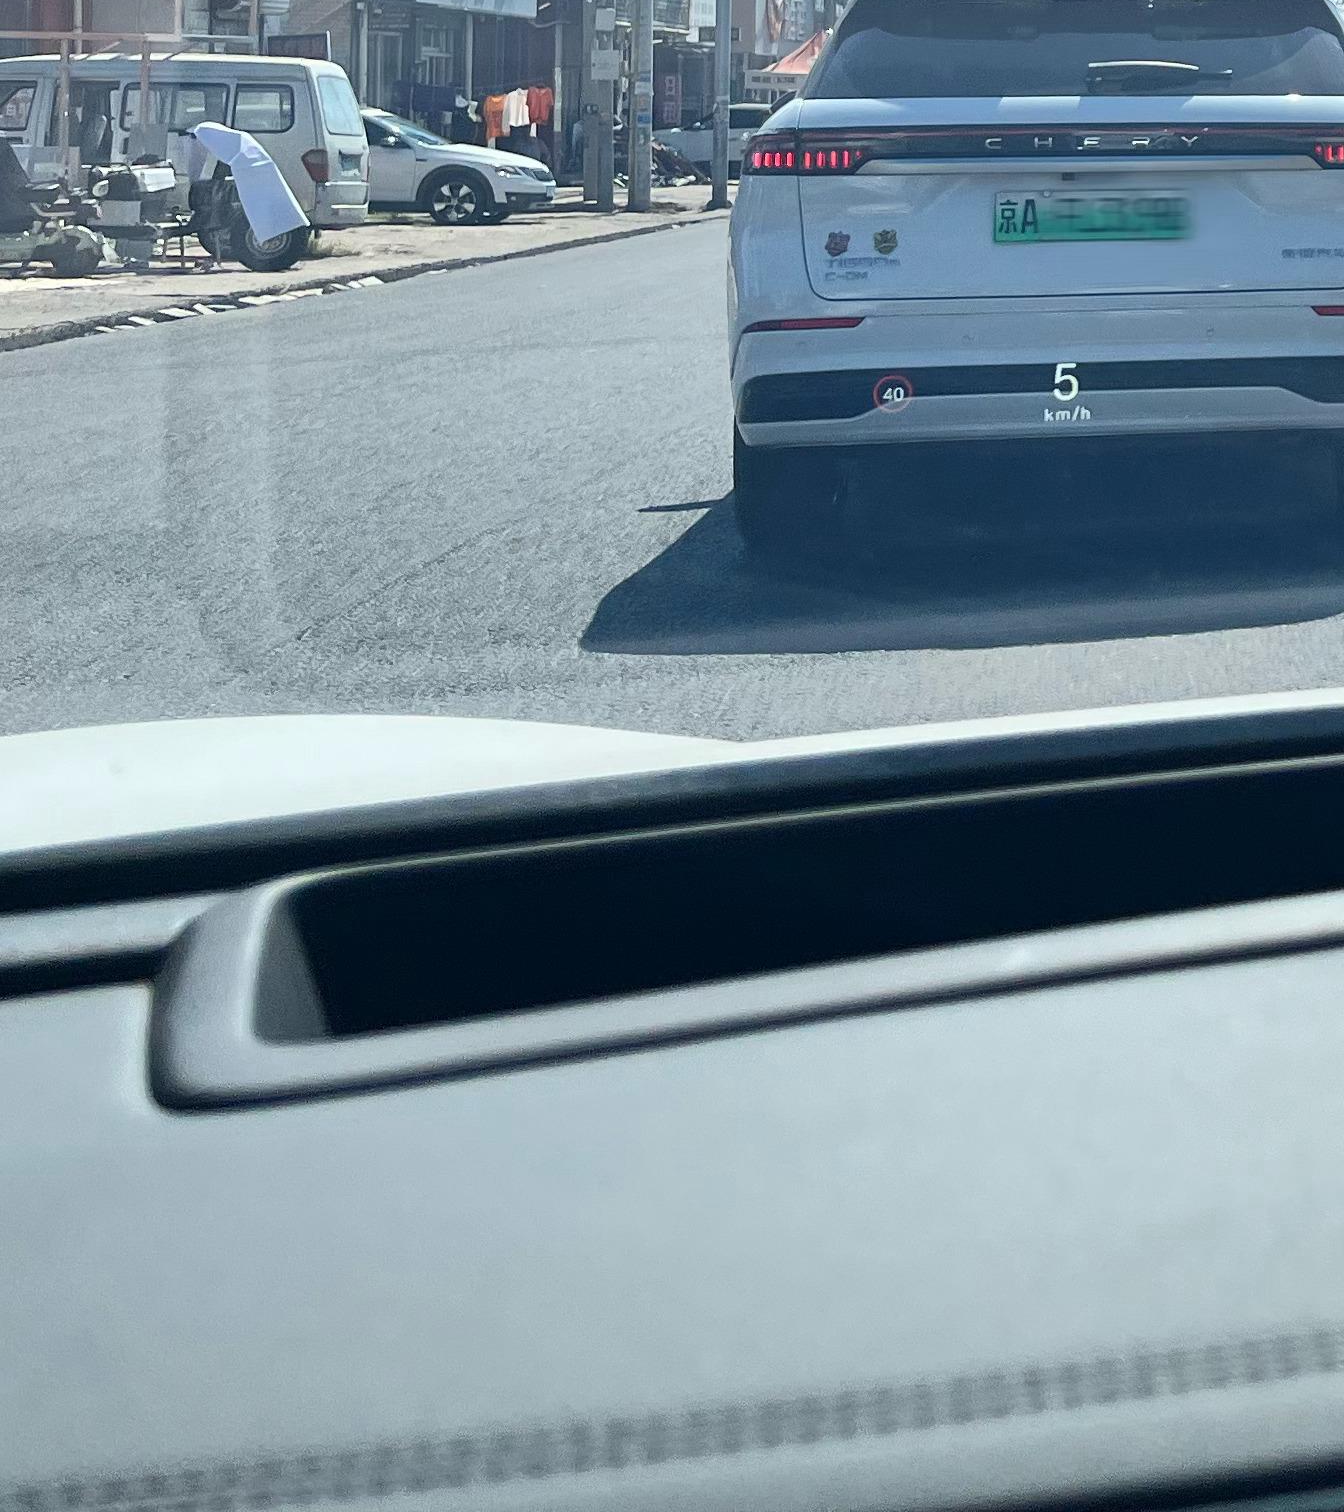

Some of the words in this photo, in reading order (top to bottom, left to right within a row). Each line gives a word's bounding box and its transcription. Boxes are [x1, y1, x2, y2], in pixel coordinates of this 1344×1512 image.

[985, 135, 1199, 151] CHERY
[1053, 362, 1080, 402] 5
[882, 386, 905, 402] 40
[1043, 405, 1091, 423] km/h
